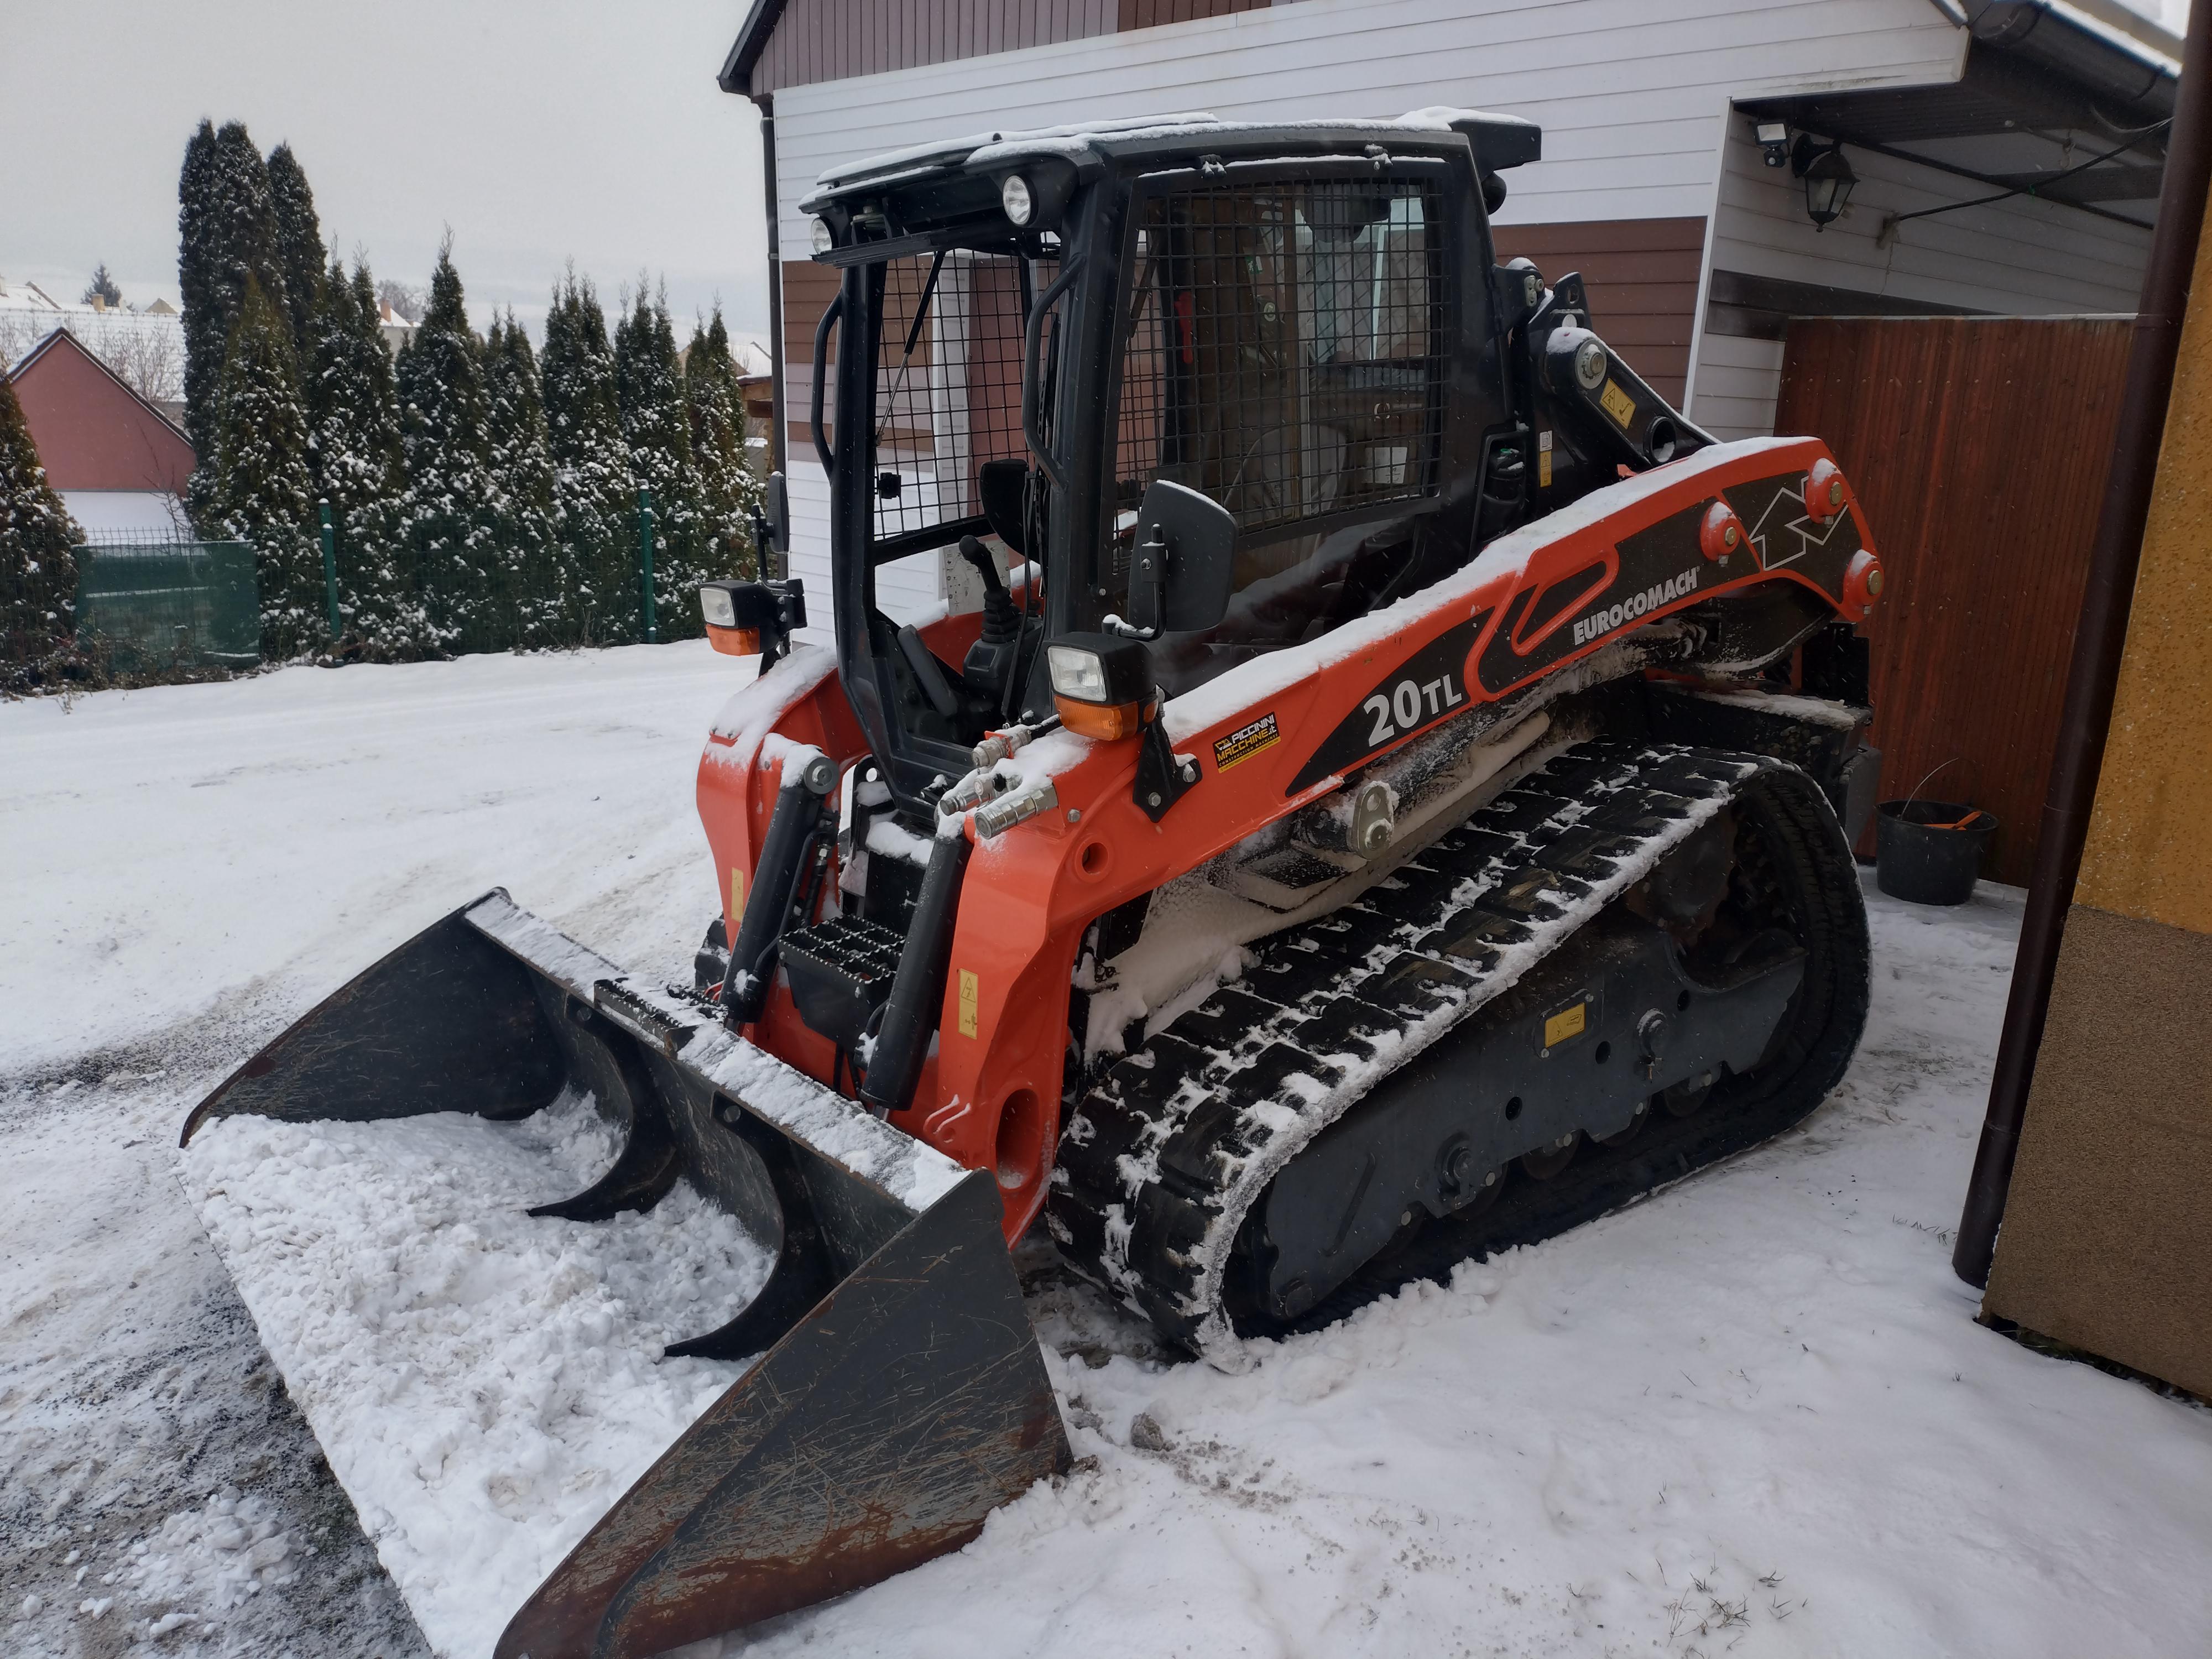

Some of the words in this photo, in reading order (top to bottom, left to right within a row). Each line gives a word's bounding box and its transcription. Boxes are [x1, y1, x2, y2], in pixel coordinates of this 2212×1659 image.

[1574, 566, 1698, 646] EUROCOMACH
[1231, 714, 1275, 744] PICCININI
[1363, 674, 1463, 747] 20TL
[1217, 725, 1277, 761] MACCHINE.it
